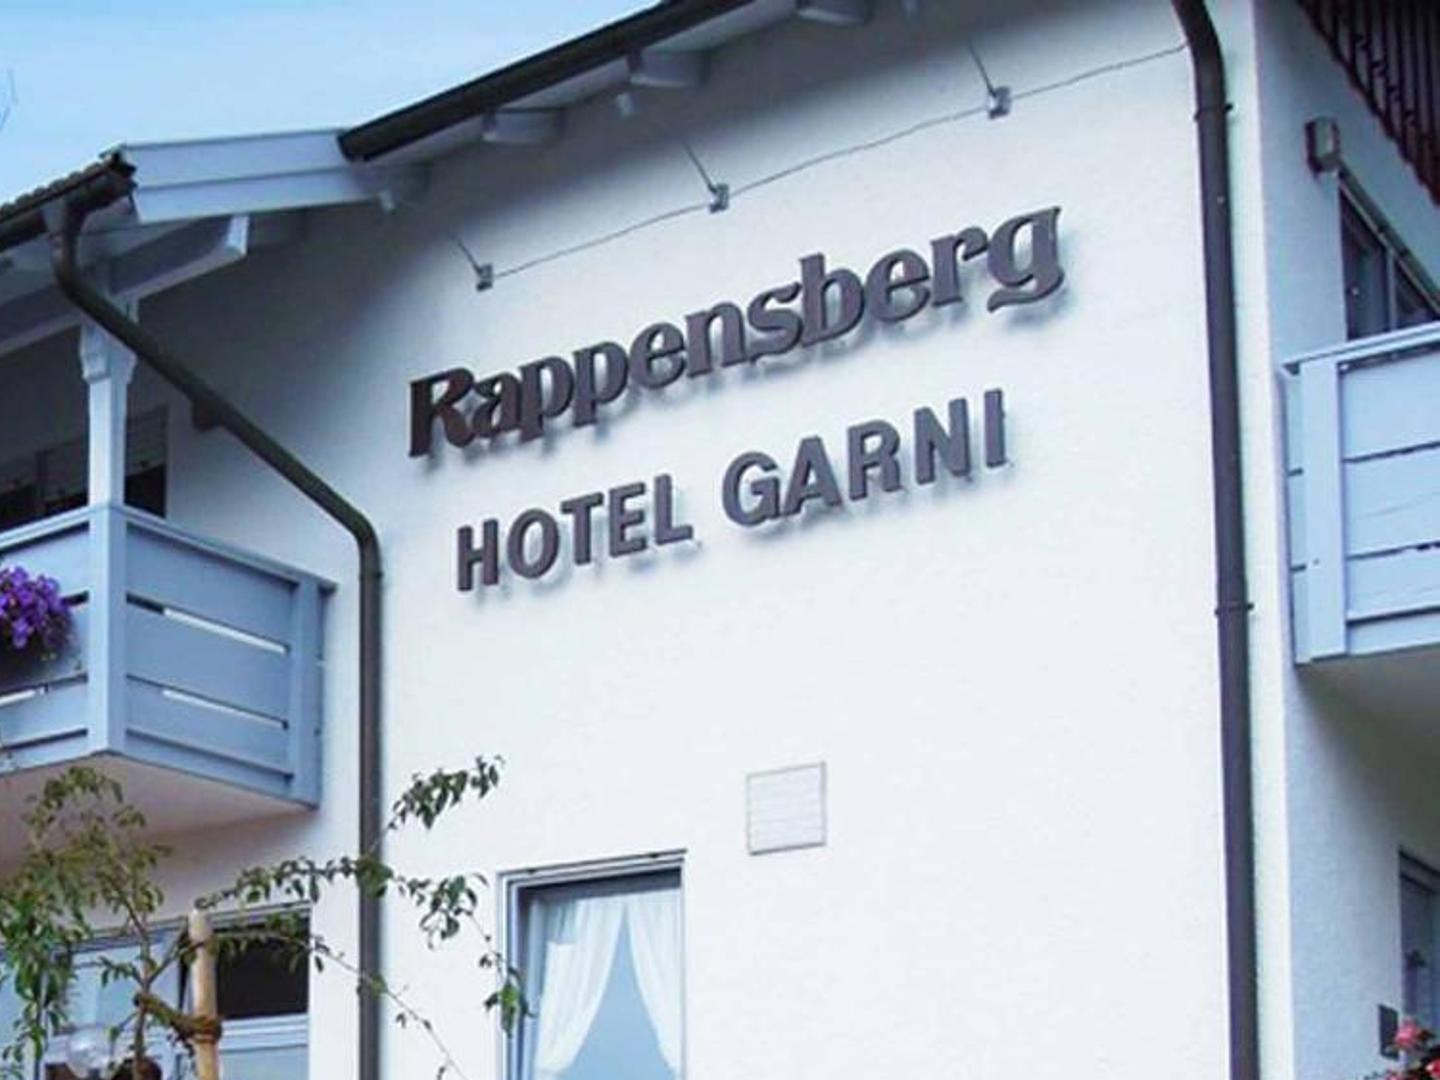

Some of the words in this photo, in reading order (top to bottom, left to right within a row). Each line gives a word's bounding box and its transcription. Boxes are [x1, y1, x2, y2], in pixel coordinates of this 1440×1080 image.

[408, 205, 1065, 459] Rappensberg
[457, 474, 694, 592] HOTEL
[722, 388, 1008, 528] GARNI
